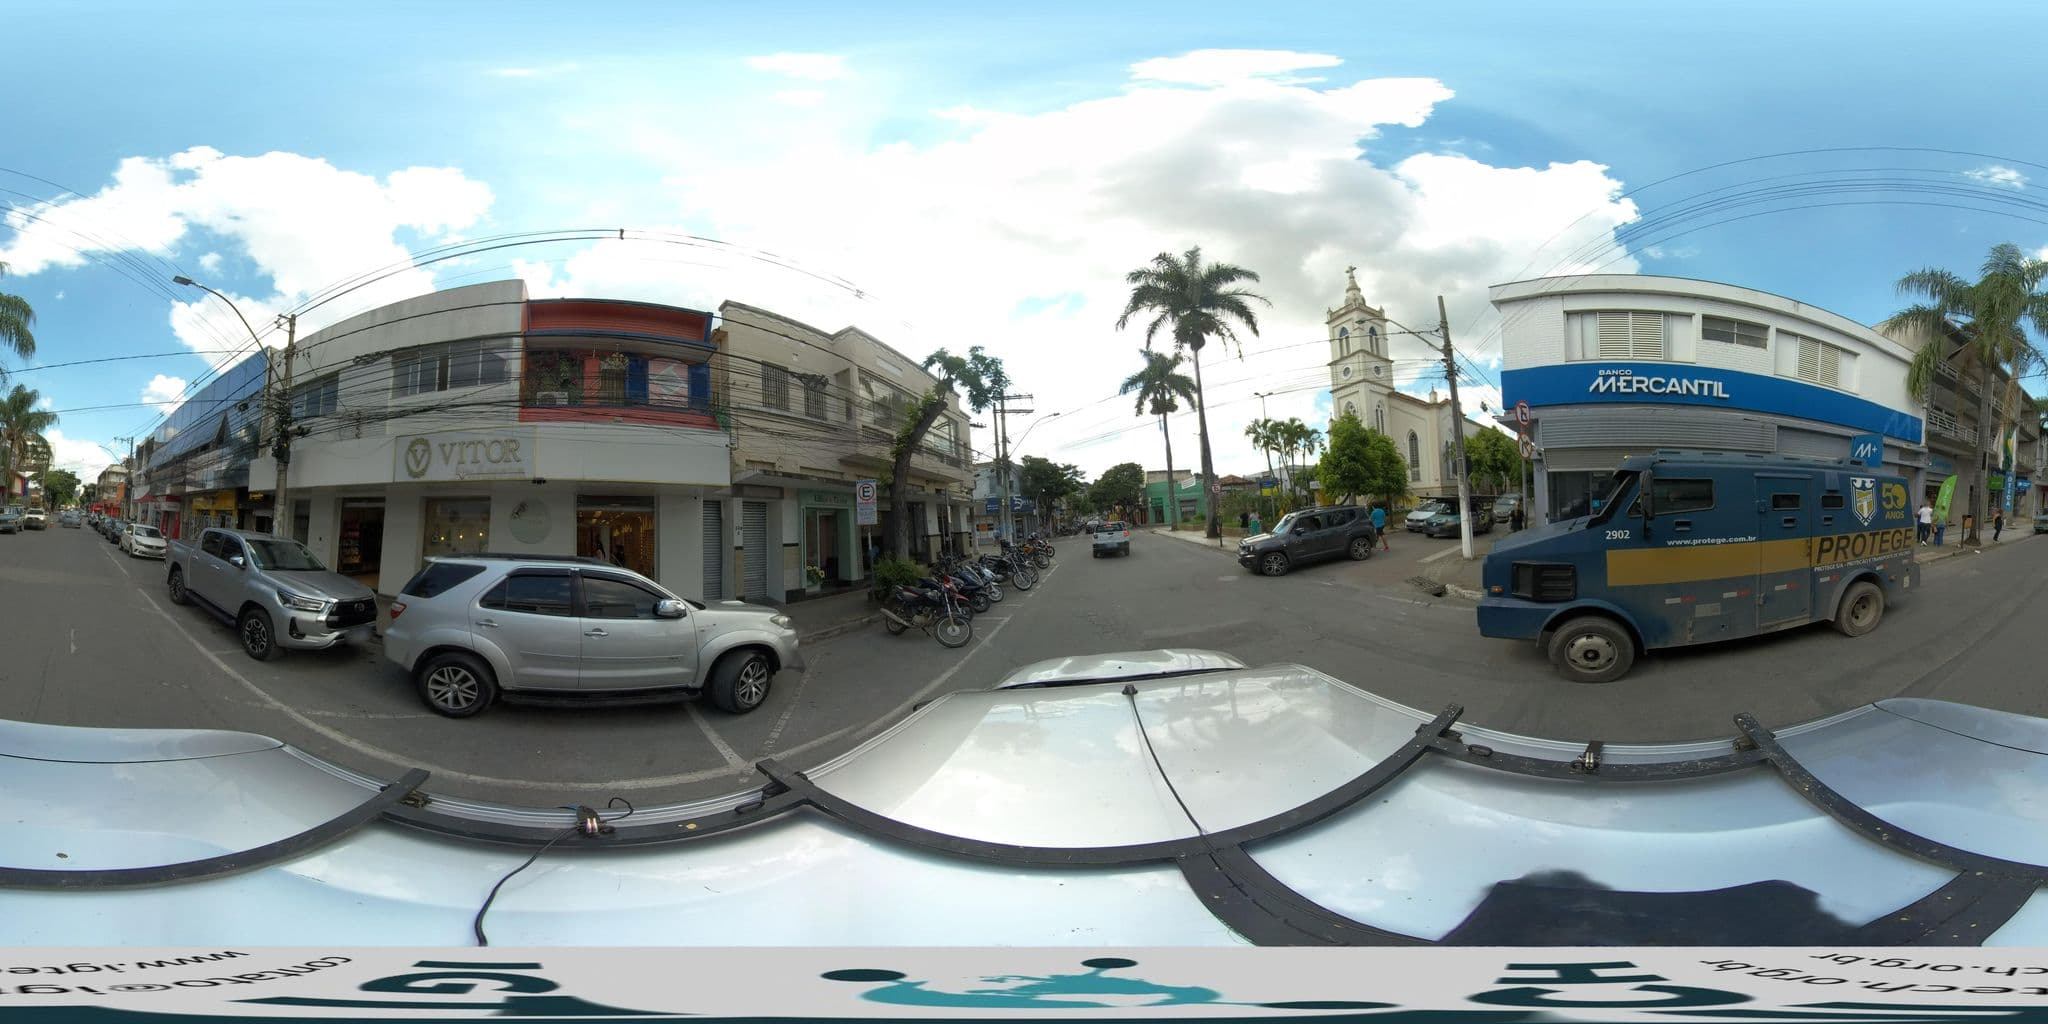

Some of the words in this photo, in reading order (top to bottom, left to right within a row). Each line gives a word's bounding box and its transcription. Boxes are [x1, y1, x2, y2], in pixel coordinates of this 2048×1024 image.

[1588, 376, 1730, 399] MERCANTIL
[438, 439, 521, 465] VITOR
[862, 486, 871, 497] E
[1881, 483, 1907, 510] 50
[1885, 511, 1905, 519] ANOS
[1605, 530, 1631, 540] 2902
[1666, 535, 1757, 546] www.protege.com.br
[1817, 528, 1914, 564] PROTEGE
